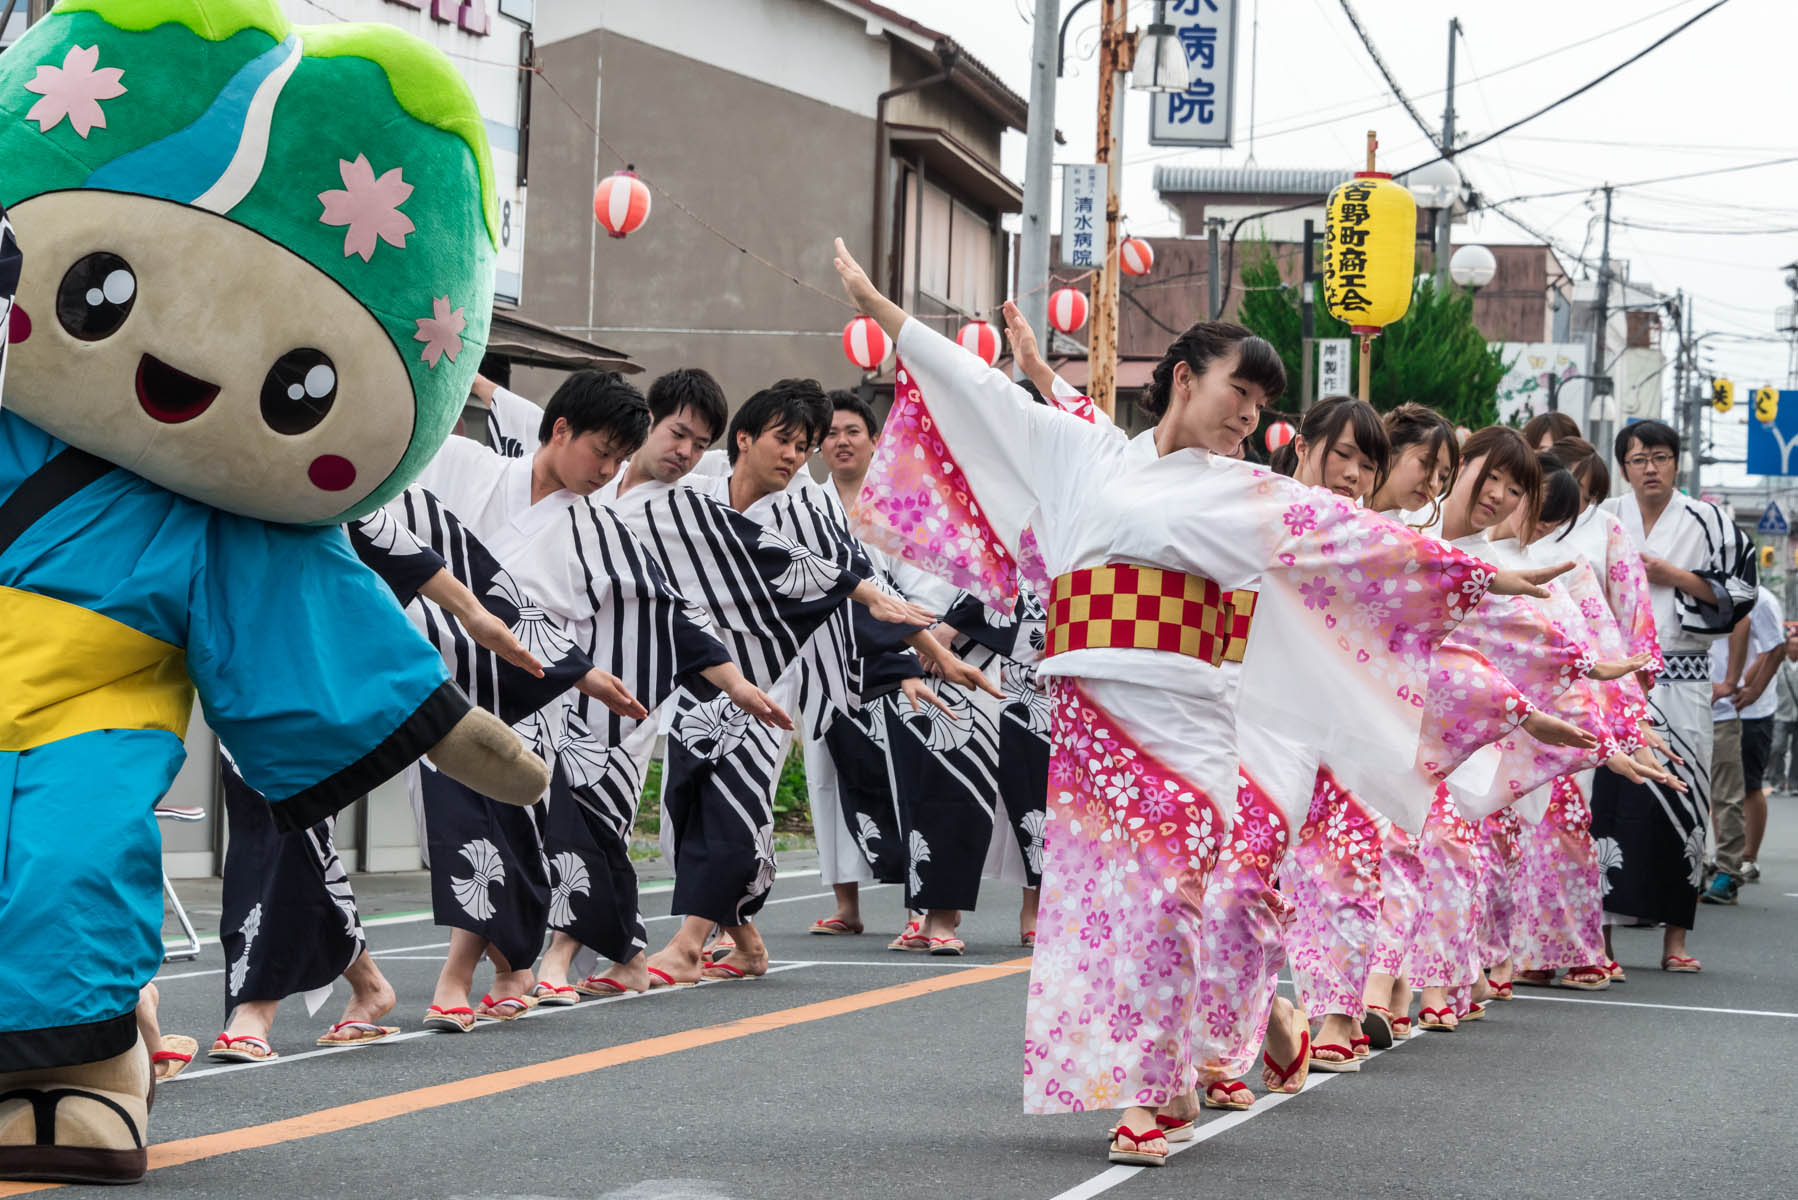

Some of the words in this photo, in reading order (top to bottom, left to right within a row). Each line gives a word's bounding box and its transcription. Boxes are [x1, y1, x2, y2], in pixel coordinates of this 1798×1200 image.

[1072, 196, 1093, 267] 清水病院
[1323, 343, 1338, 396] 岸製作
